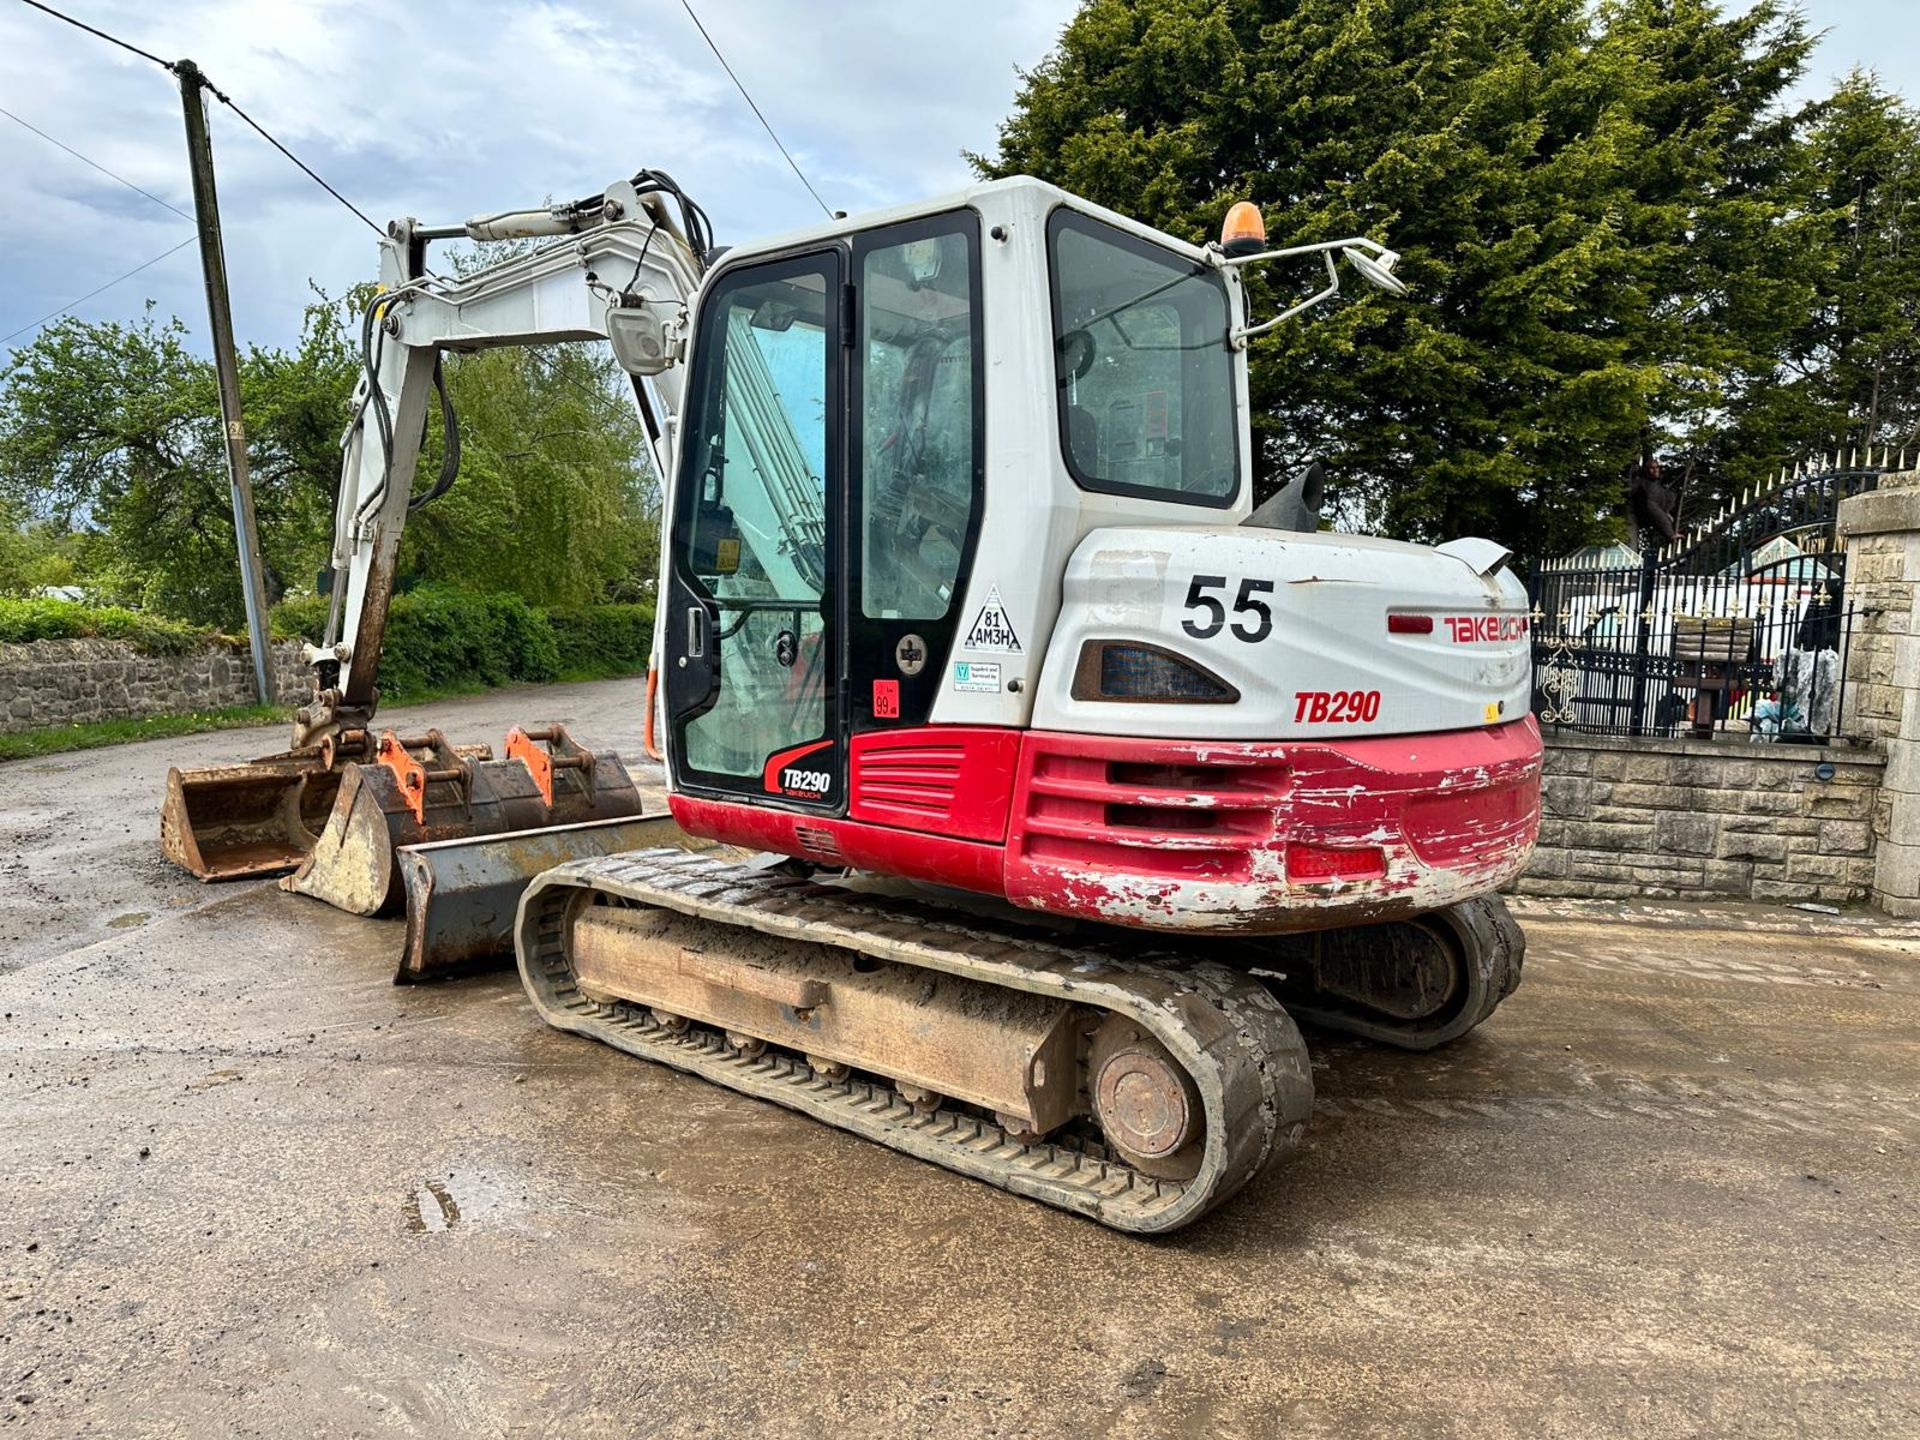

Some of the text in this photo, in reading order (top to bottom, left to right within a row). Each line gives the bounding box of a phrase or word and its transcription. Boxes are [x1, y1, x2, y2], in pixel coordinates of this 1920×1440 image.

[985, 611, 1000, 628] 81
[1181, 574, 1274, 643] 55
[976, 628, 1010, 646] AM3H
[1444, 617, 1526, 643] TAKEUCH
[877, 695, 889, 714] 99
[1294, 690, 1381, 723] TB290
[784, 768, 831, 793] TB290
